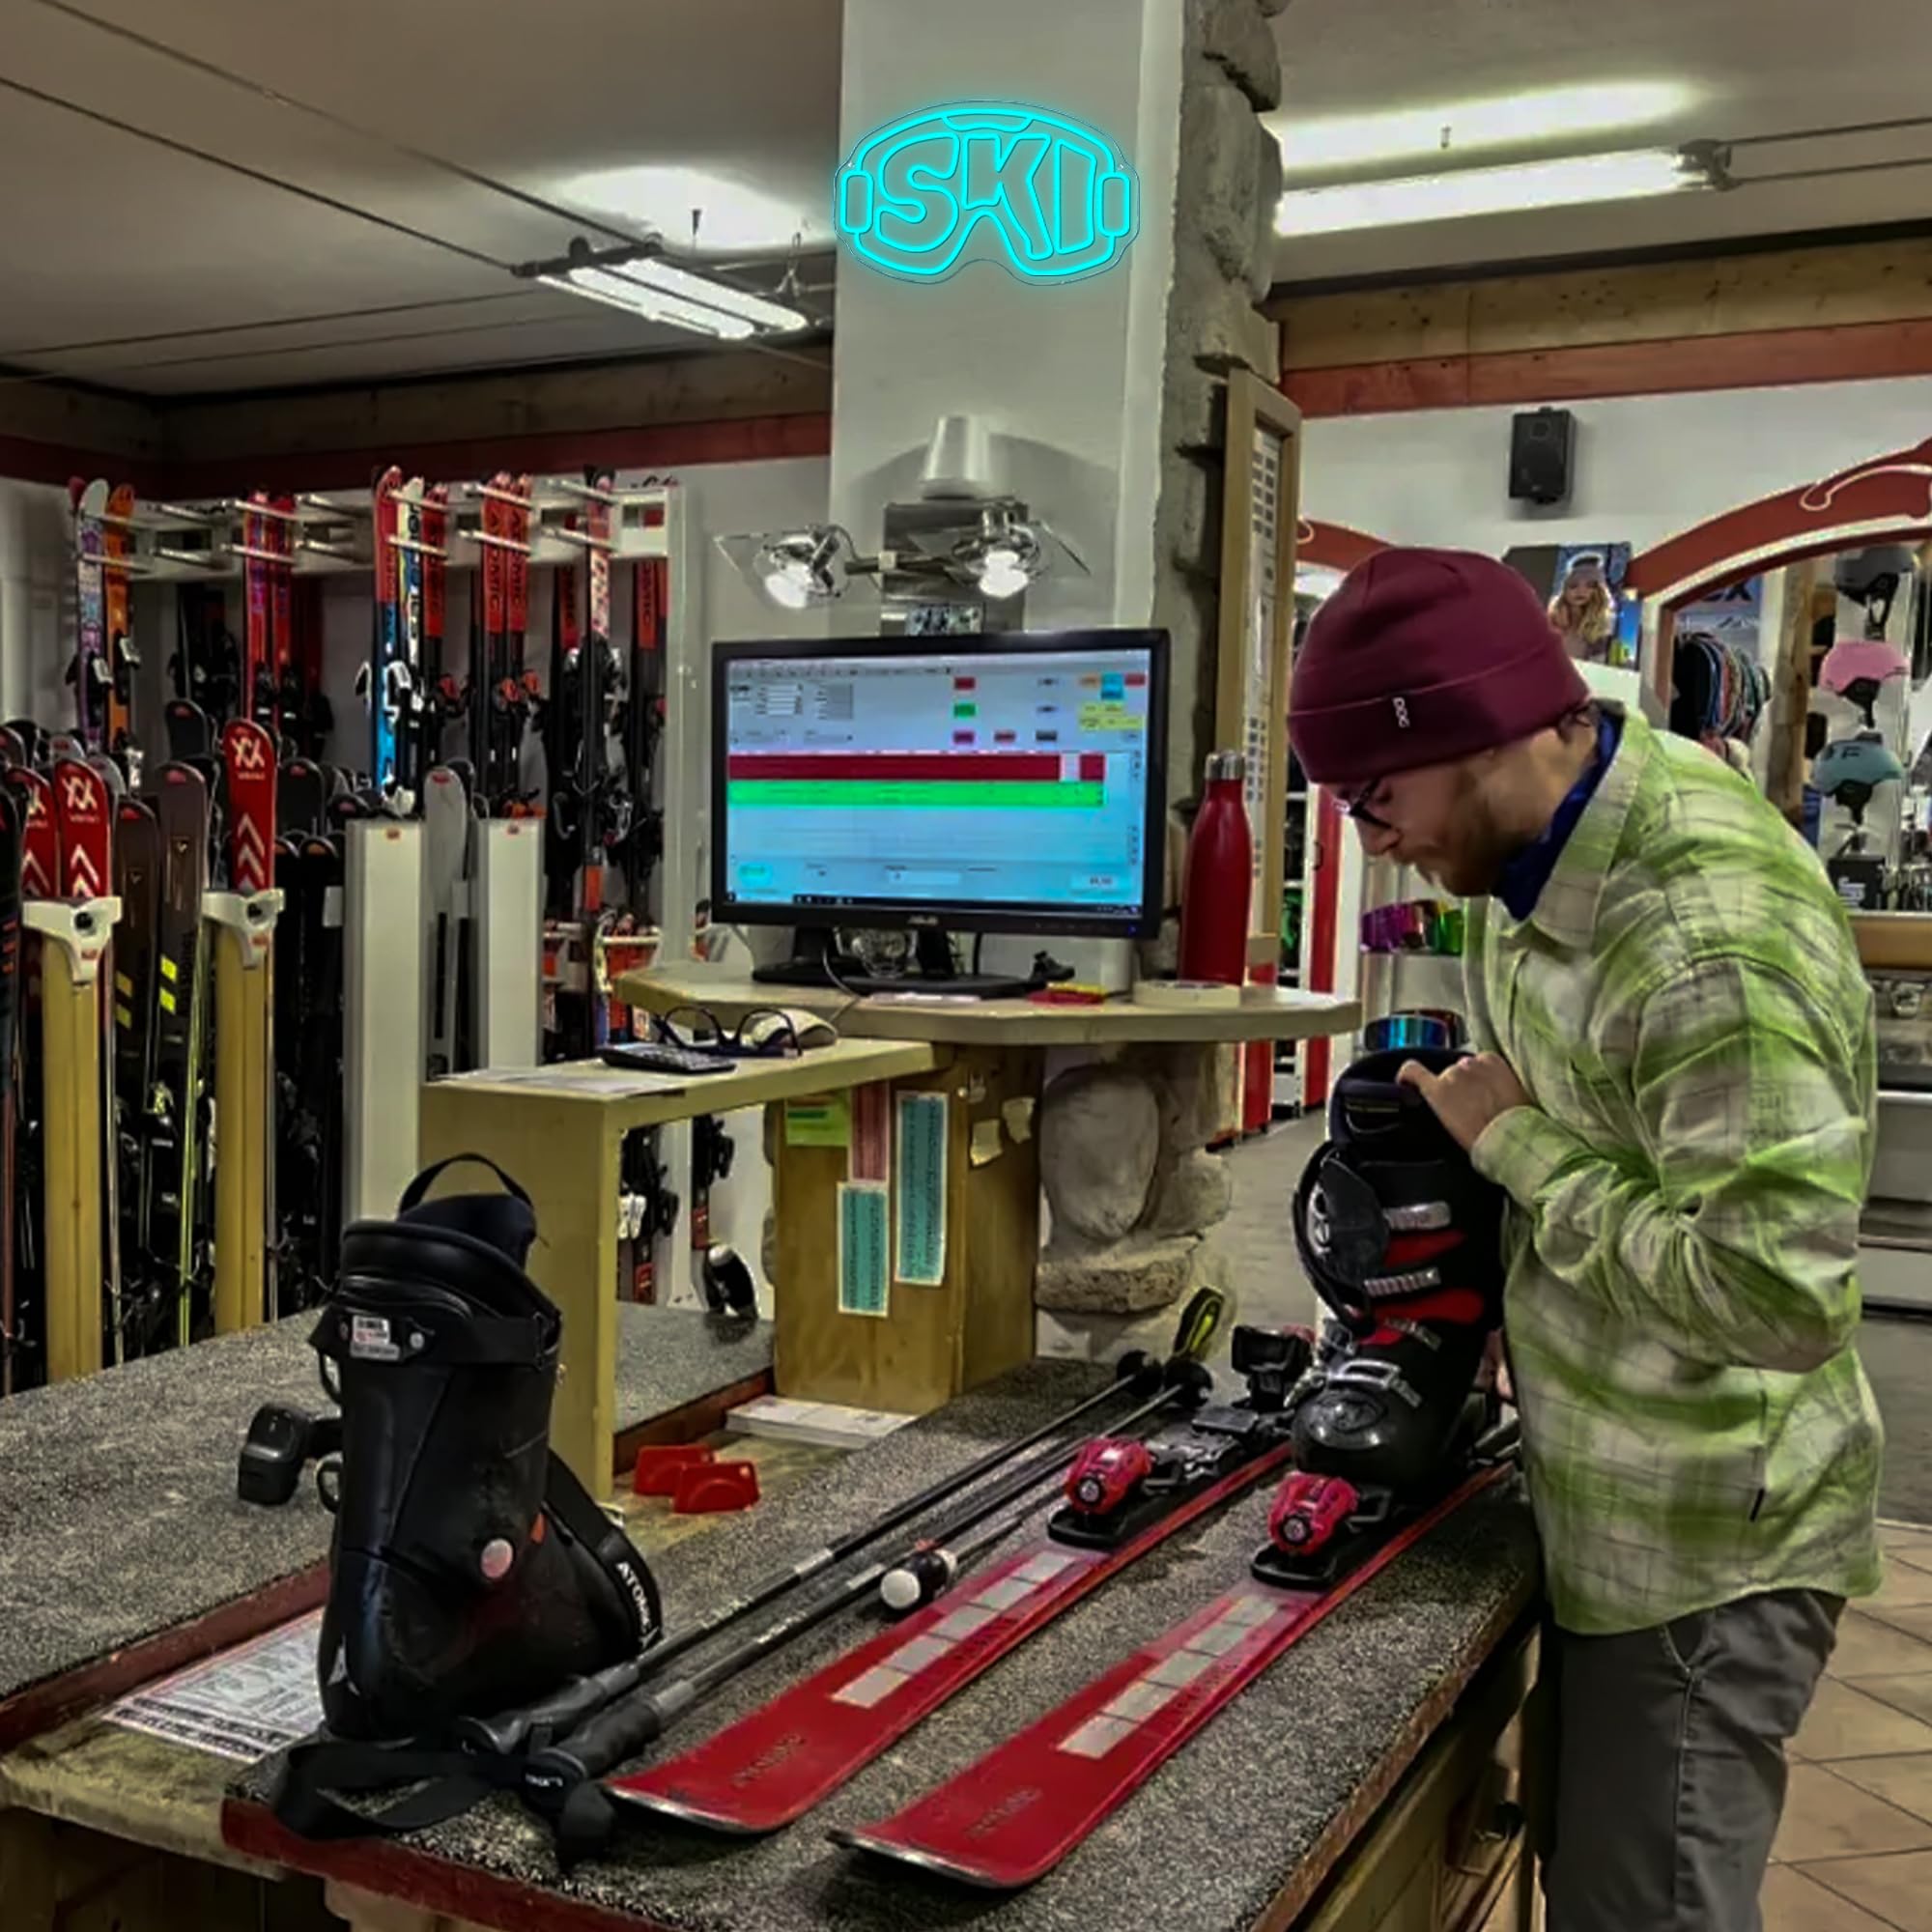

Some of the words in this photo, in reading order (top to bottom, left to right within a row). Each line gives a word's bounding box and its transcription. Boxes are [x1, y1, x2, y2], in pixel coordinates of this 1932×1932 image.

[874, 131, 1097, 261] SKI
[1393, 696, 1410, 728] POC
[616, 1561, 653, 1634] ATOMIC
